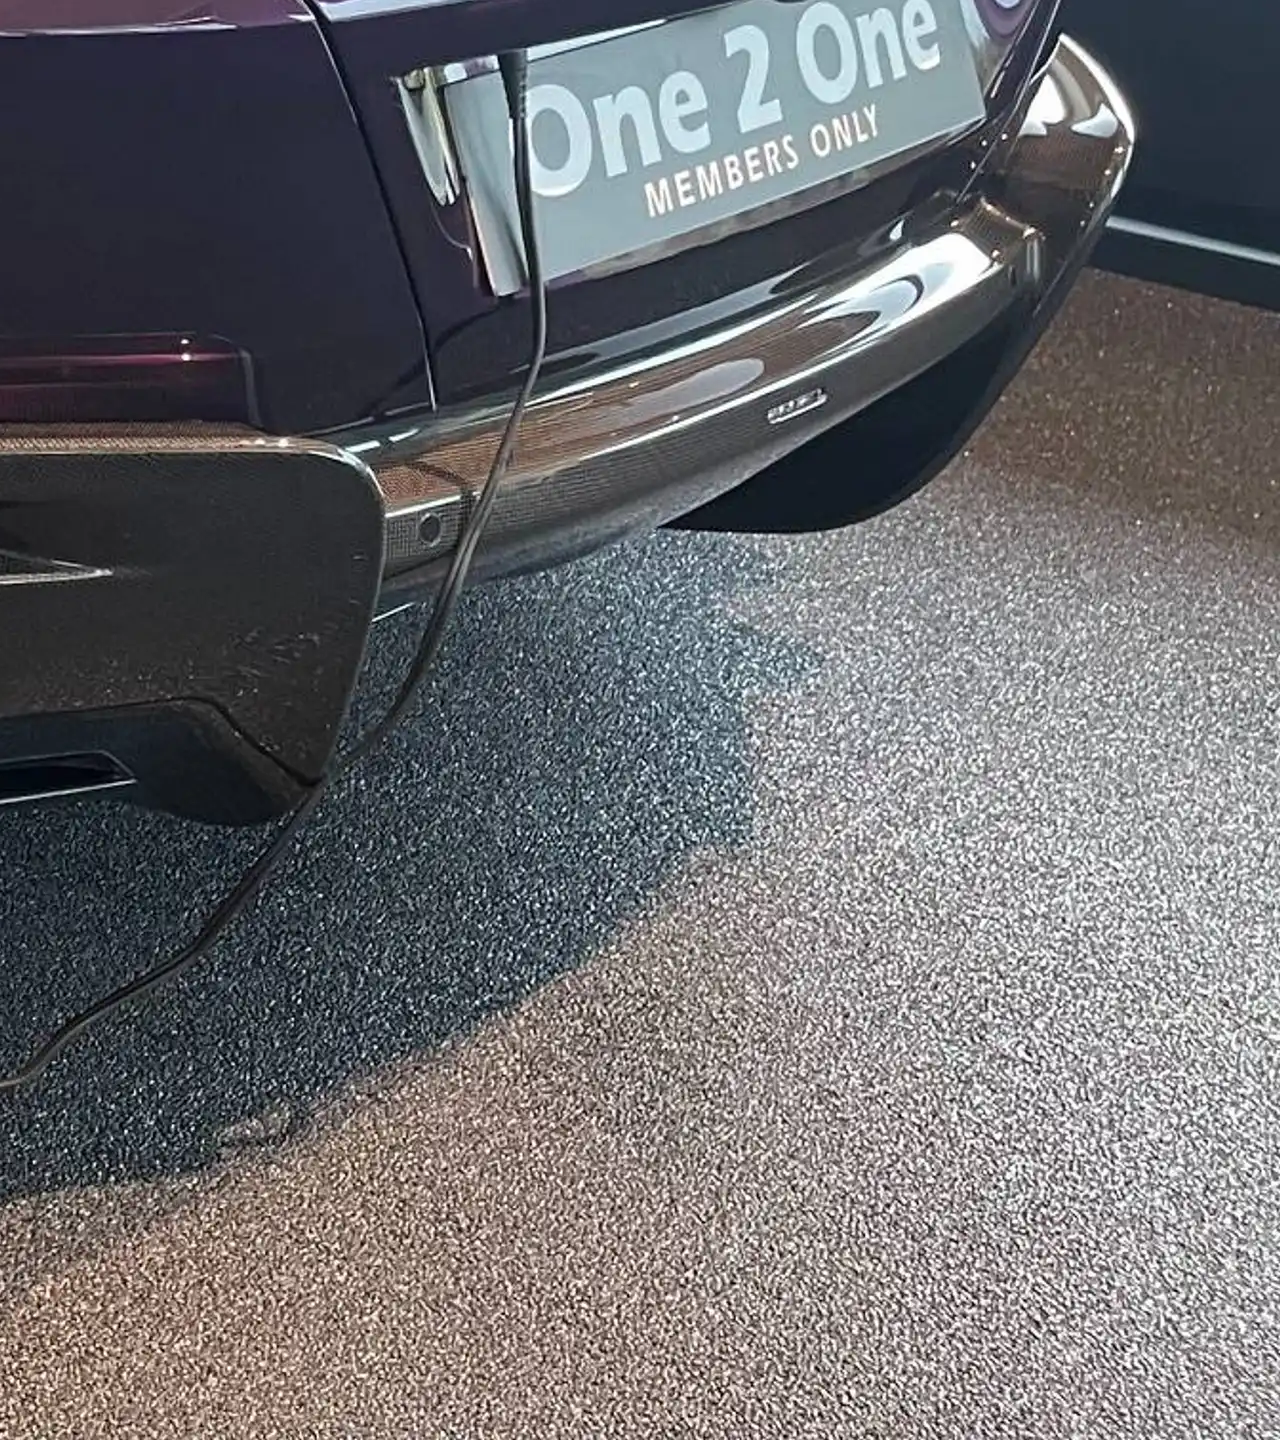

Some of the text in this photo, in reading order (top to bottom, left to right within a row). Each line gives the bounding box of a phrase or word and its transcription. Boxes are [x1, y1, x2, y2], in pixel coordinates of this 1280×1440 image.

[526, 71, 711, 197] One
[724, 24, 783, 134] 2
[644, 103, 879, 219] MEMBERS ONLY
